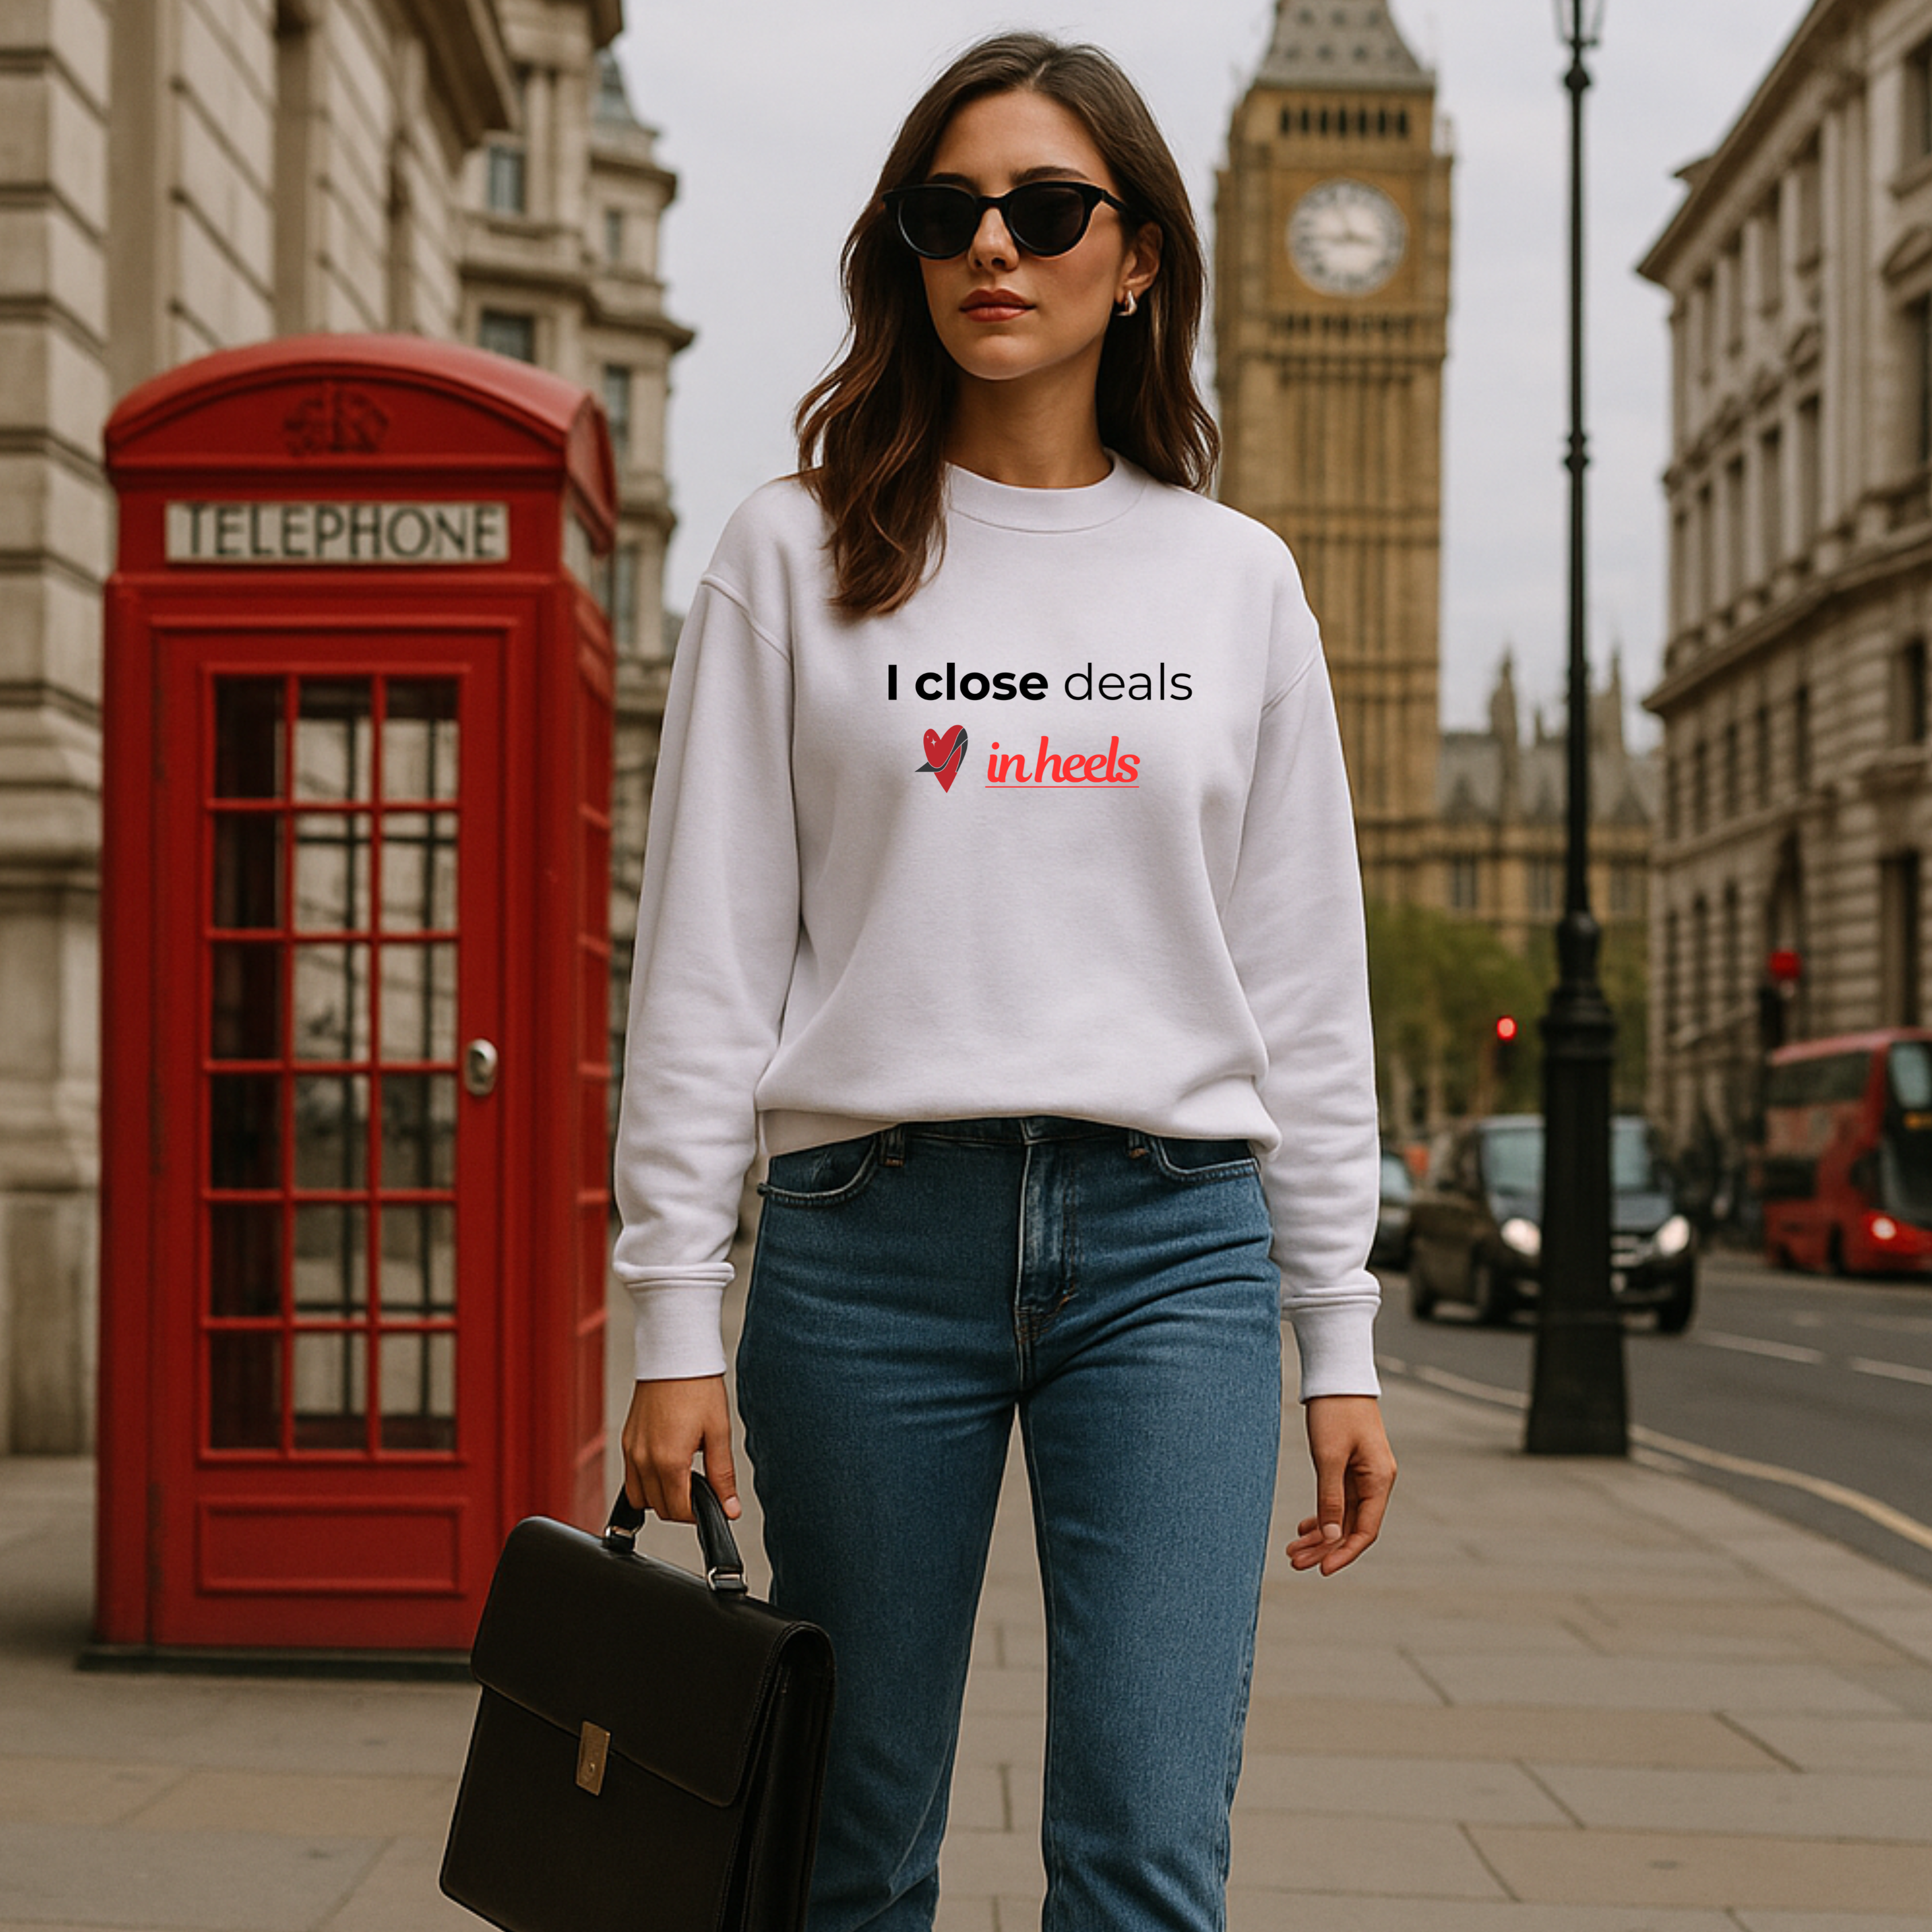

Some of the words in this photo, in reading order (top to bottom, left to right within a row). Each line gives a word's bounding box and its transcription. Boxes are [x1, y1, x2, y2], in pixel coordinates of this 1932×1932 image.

[186, 506, 499, 556] TELEPHONE
[888, 664, 897, 701] I
[915, 662, 1048, 701] close
[1064, 662, 1192, 701] deals
[987, 742, 1033, 783] in
[1034, 736, 1141, 783] heels
